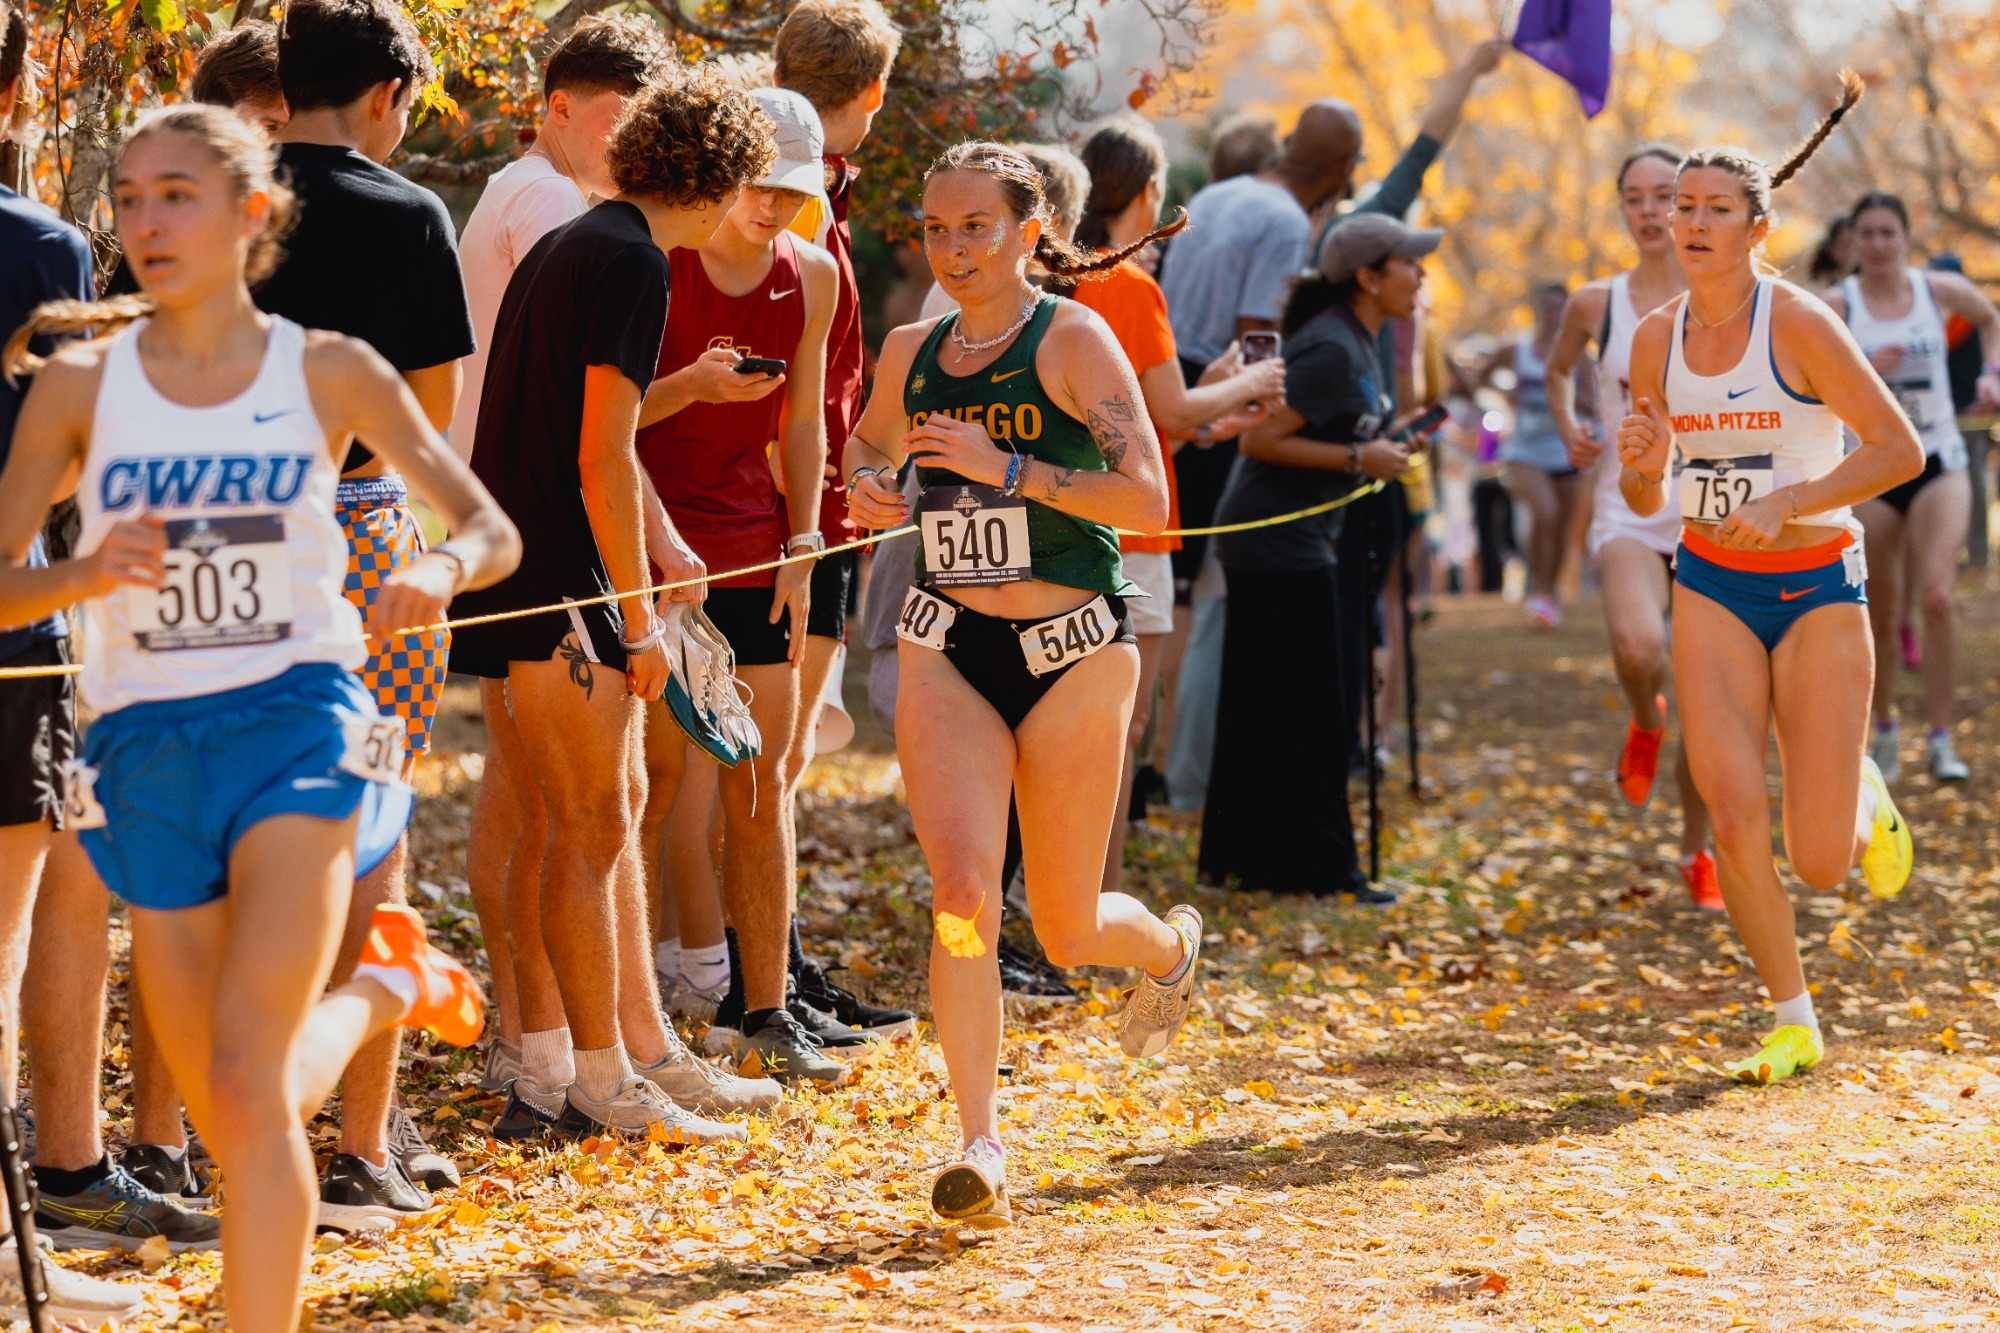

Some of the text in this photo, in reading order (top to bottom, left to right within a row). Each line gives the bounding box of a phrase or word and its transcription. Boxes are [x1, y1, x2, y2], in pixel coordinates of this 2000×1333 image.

[1718, 411, 1782, 430] PITZER
[101, 453, 313, 512] CWRU
[1696, 476, 1752, 518] 752
[936, 517, 1009, 570] 540
[158, 559, 261, 627] 503
[1037, 607, 1105, 663] 540
[520, 1095, 559, 1121] saucony
